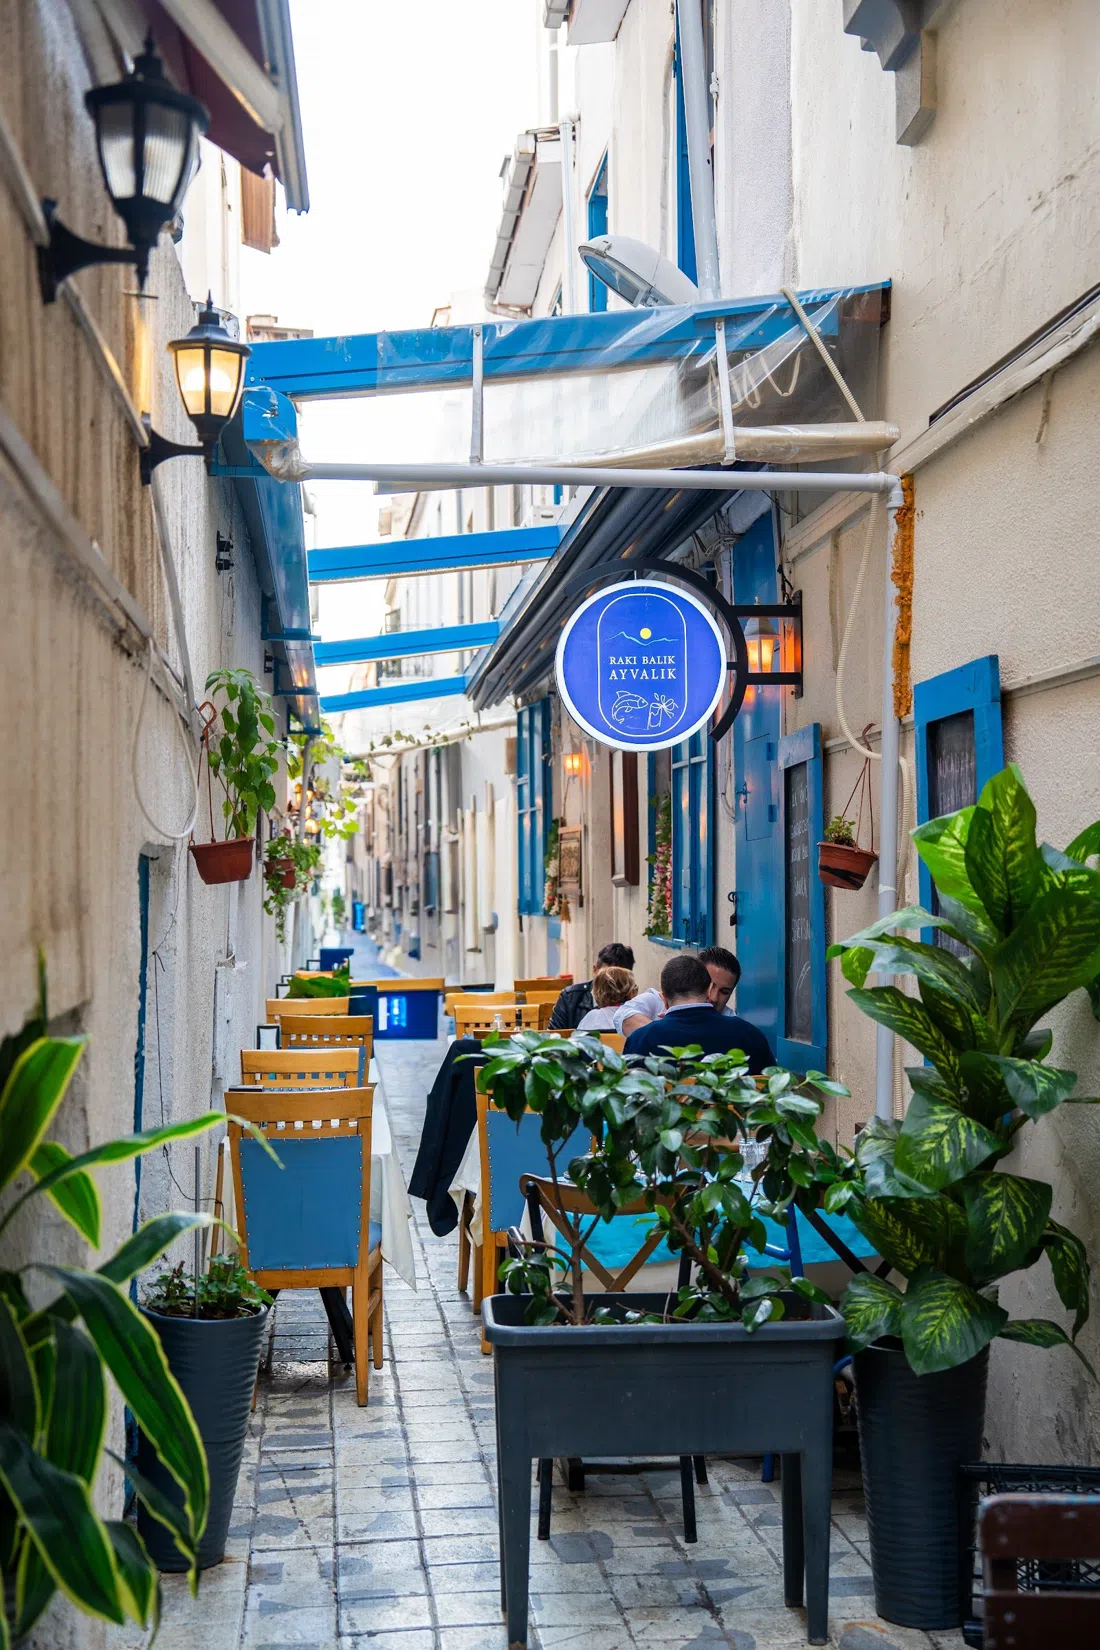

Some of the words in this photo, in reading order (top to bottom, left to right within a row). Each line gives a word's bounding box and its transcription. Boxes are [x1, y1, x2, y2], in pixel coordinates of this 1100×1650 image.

[609, 656, 637, 665] RAKI
[642, 656, 676, 665] BALIK
[609, 668, 676, 680] AYVALIK
